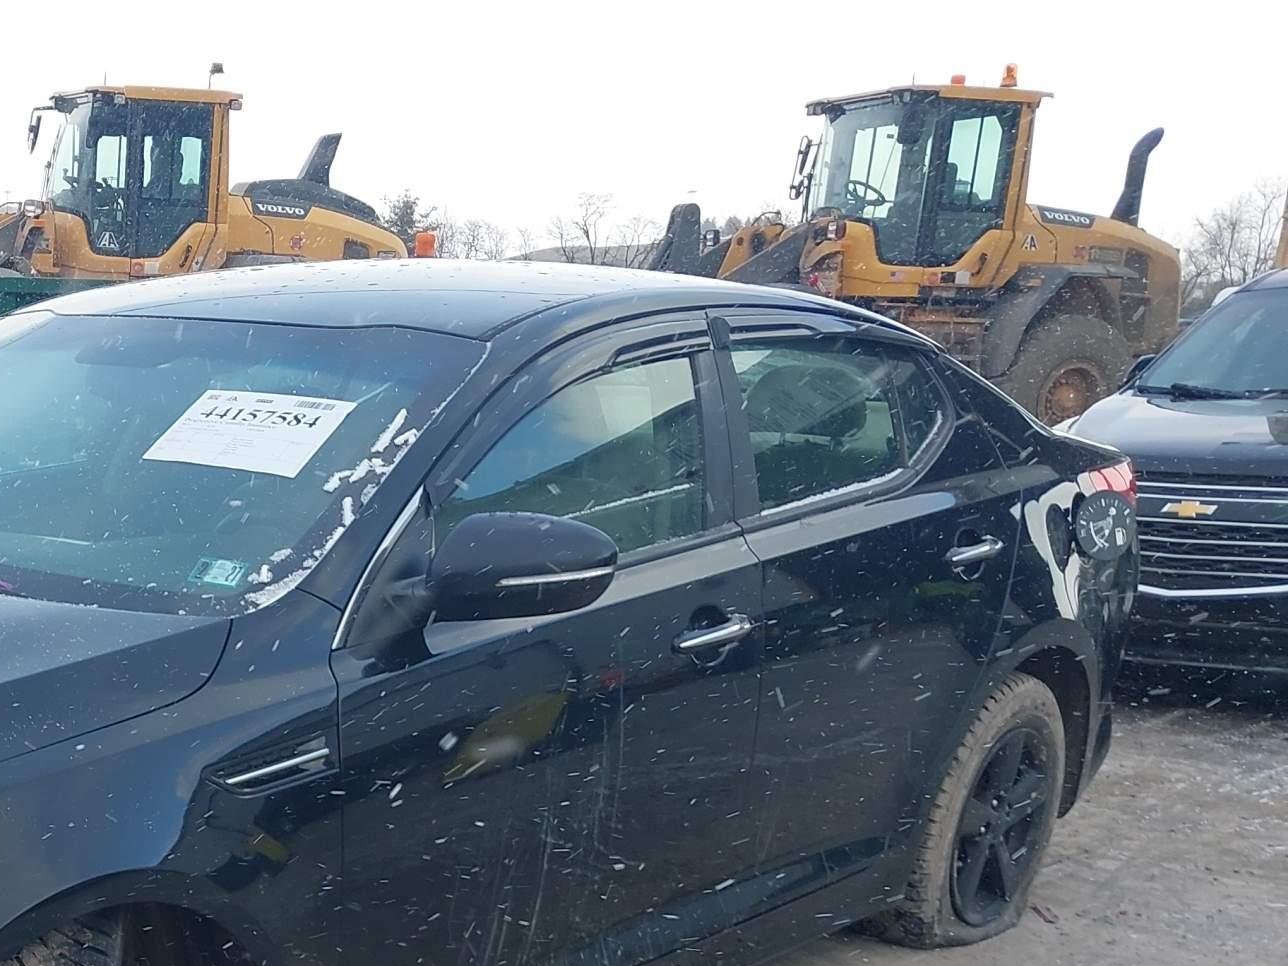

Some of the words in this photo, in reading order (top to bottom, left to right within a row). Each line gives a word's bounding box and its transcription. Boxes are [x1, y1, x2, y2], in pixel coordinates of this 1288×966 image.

[255, 203, 305, 215] VOLVO
[1043, 210, 1090, 224] VOLVO
[200, 406, 322, 429] 44157584
